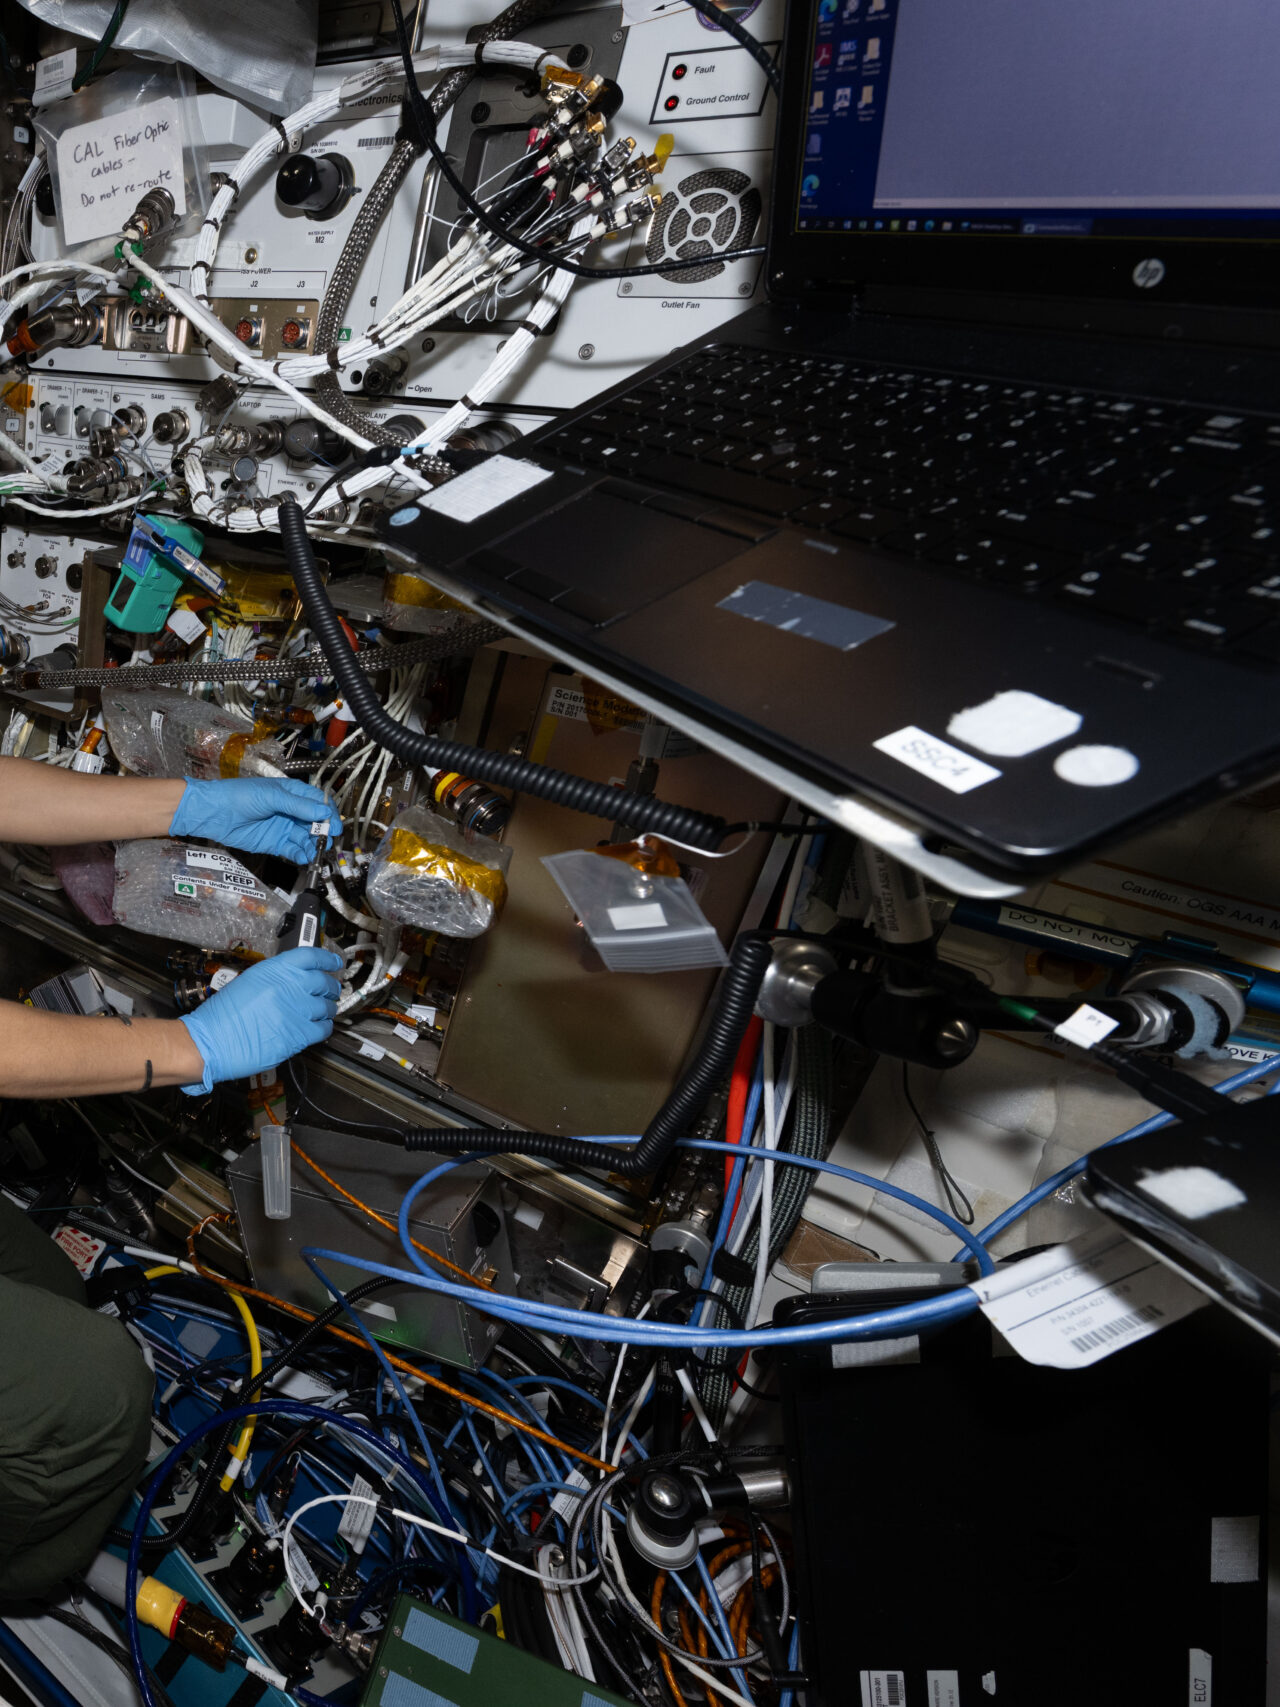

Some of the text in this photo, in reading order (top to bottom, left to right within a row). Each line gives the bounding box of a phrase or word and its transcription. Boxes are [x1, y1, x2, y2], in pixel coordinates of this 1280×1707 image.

[694, 65, 715, 75] Fault
[686, 92, 750, 106] Ground Control
[73, 121, 170, 164] CAL Fiber Optic
[91, 159, 123, 178] cables
[81, 170, 172, 208] Do not re-route
[661, 301, 685, 309] Outlet
[414, 385, 433, 394] Open
[361, 412, 388, 420] OOLANT
[552, 700, 563, 708] P/N
[554, 689, 599, 706] Science
[550, 706, 577, 718] S/N 001
[901, 739, 969, 776] SSC4
[187, 851, 207, 860] Left
[210, 854, 233, 865] CO2
[173, 875, 265, 898] Contents Under Pressure
[225, 873, 254, 886] KEEP
[882, 891, 899, 932] BRACKET
[1121, 880, 1182, 904] Caution:
[1186, 897, 1226, 916] OGS
[1229, 909, 1265, 928] AAA
[1008, 910, 1038, 925] DO
[1043, 921, 1086, 937] NOT
[60, 1236, 73, 1248] FIRE
[73, 1245, 88, 1259] PORT
[1026, 1276, 1065, 1298] Ethernet
[1194, 1677, 1207, 1703] ELC7
